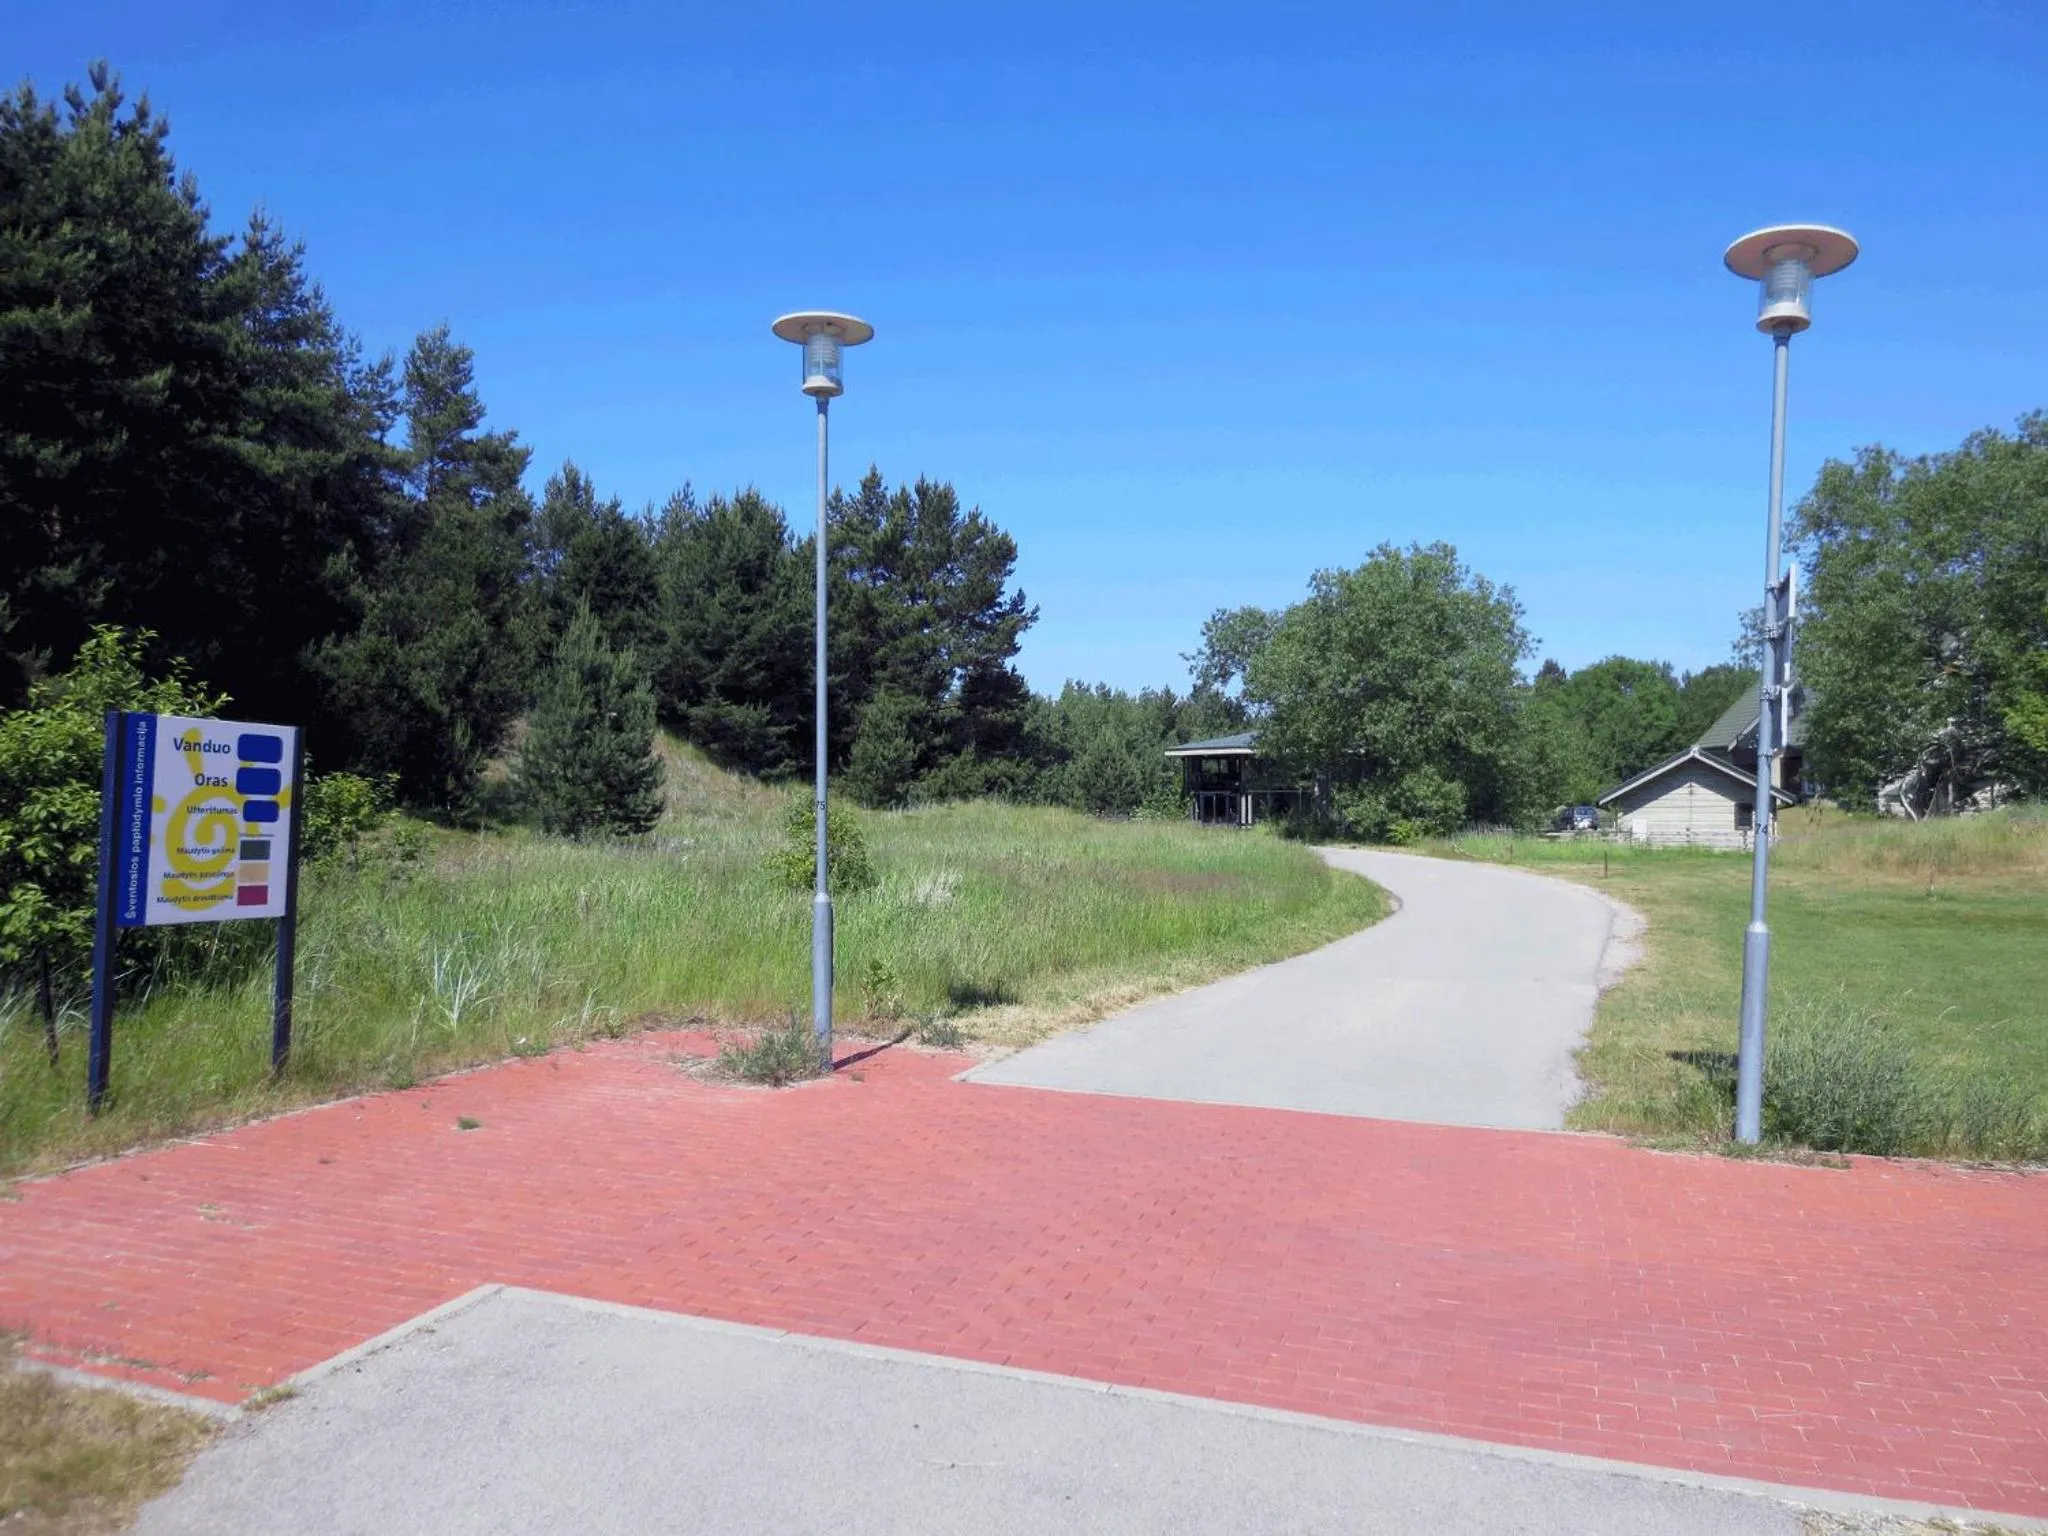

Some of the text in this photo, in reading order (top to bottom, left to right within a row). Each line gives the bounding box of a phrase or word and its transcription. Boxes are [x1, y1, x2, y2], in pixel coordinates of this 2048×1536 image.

[173, 738, 231, 754] Vanduo
[194, 772, 228, 787] Oras
[125, 856, 140, 919] Šventosios
[134, 720, 148, 785] informacija
[1755, 822, 1768, 834] 74
